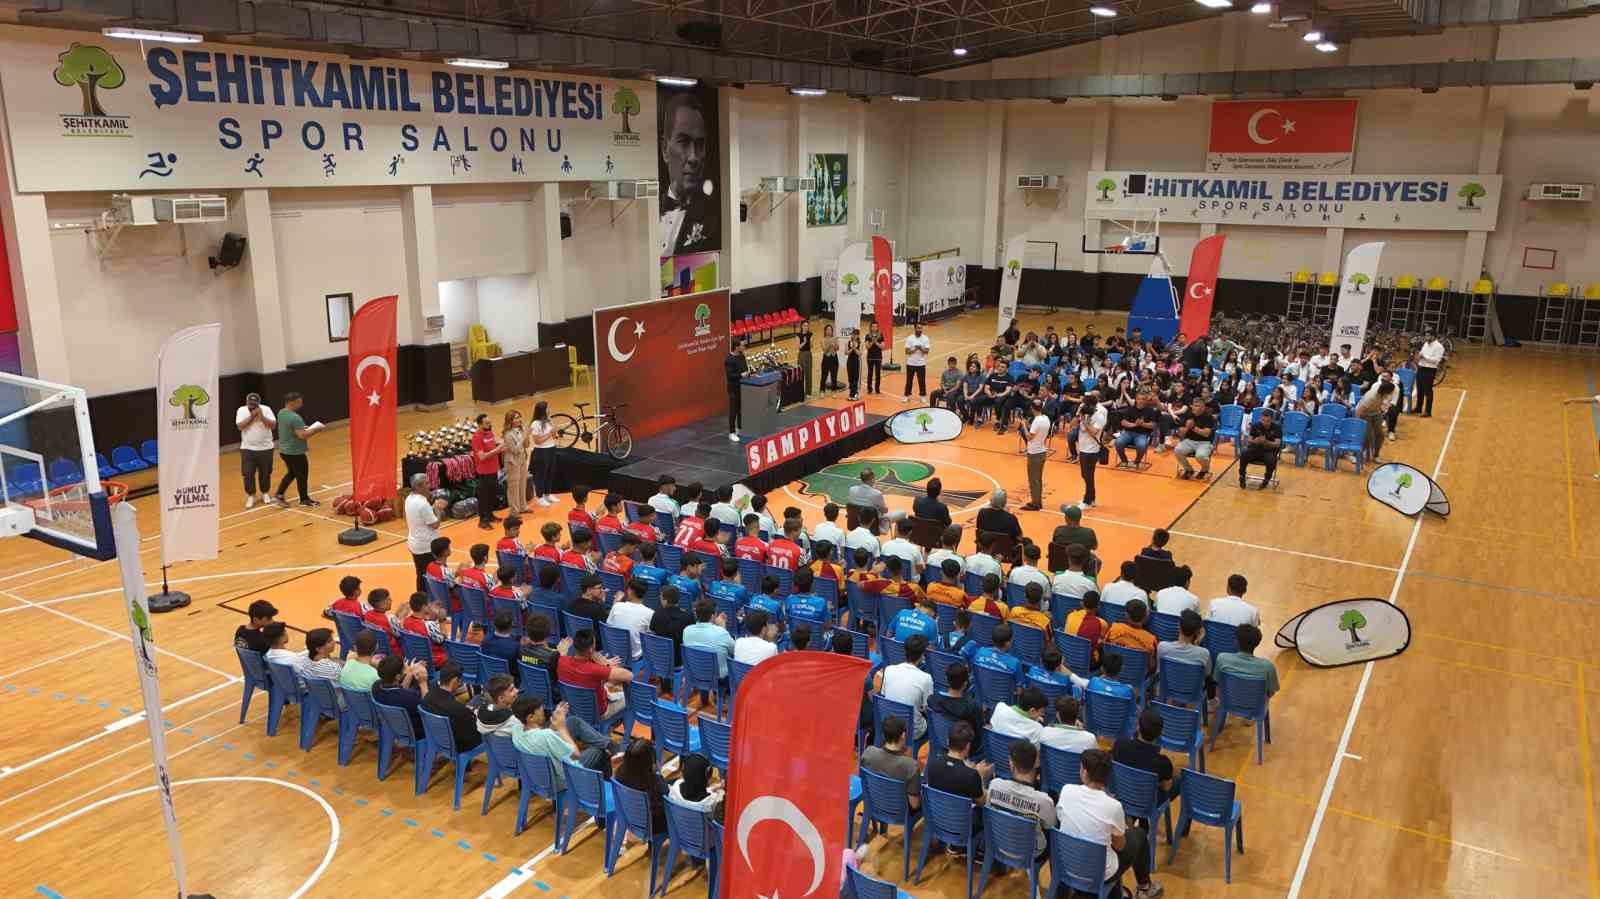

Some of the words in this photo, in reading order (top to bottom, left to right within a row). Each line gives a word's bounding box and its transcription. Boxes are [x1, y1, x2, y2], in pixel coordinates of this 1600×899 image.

[218, 117, 364, 150] SPOR
[401, 124, 561, 152] SALONU
[1199, 201, 1248, 211] SPOR
[1262, 202, 1343, 213] SALONU
